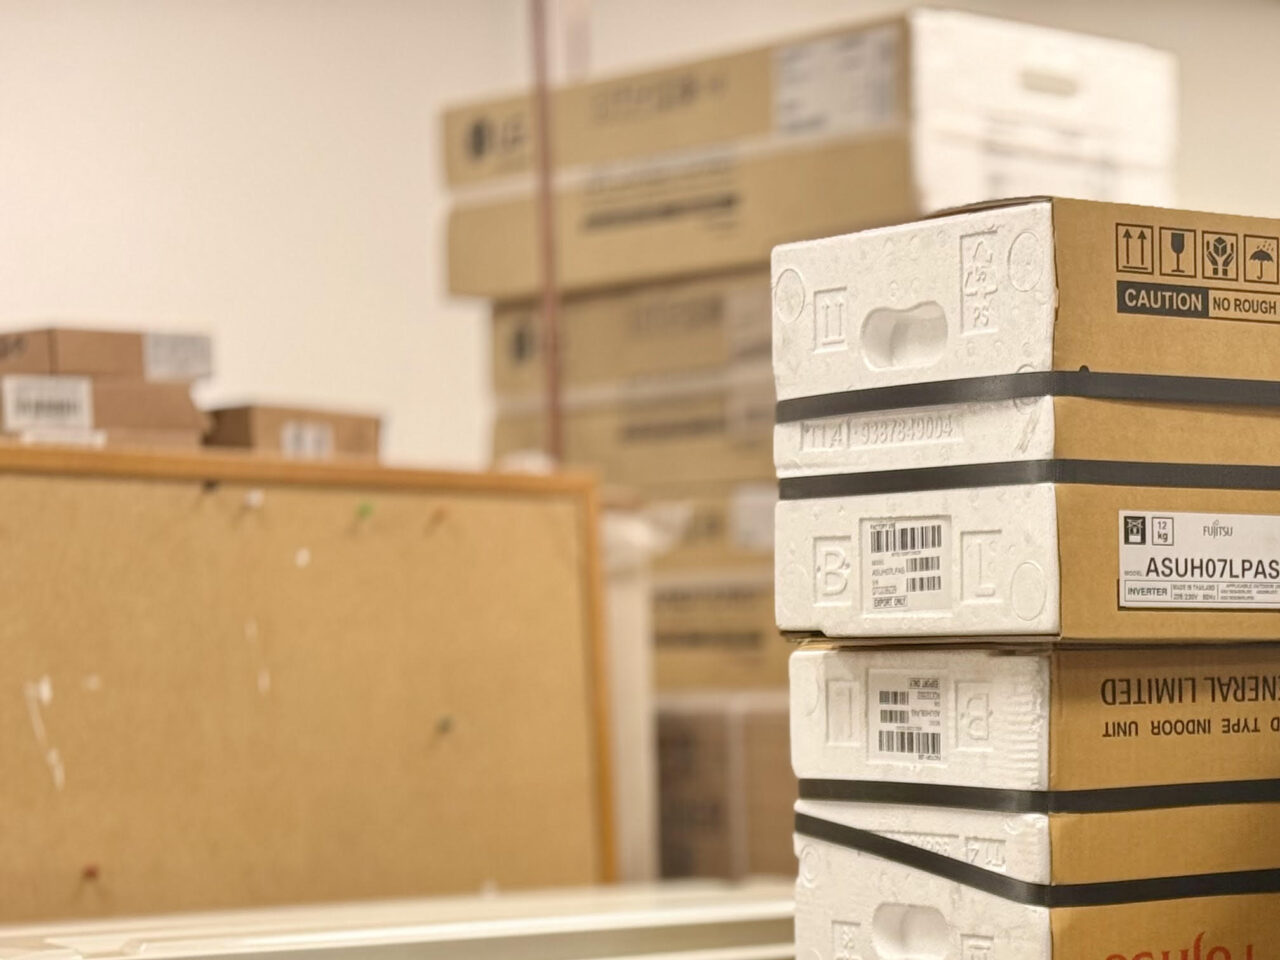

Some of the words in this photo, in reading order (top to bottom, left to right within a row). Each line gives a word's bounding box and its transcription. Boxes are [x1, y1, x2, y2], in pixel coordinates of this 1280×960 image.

[1125, 288, 1202, 312] CAUTION
[1212, 299, 1231, 313] NO
[1233, 300, 1277, 317] ROUGH
[1157, 521, 1168, 530] 12
[1202, 520, 1234, 539] FUJITSU
[1157, 531, 1168, 543] kg
[1145, 557, 1280, 579] ASUH07LPAS
[1127, 587, 1168, 597] INVERTER
[1101, 677, 1197, 706] LIMITED
[1102, 721, 1139, 738] UNIT
[1151, 718, 1211, 736] INDOOR
[1222, 717, 1261, 734] TYPE
